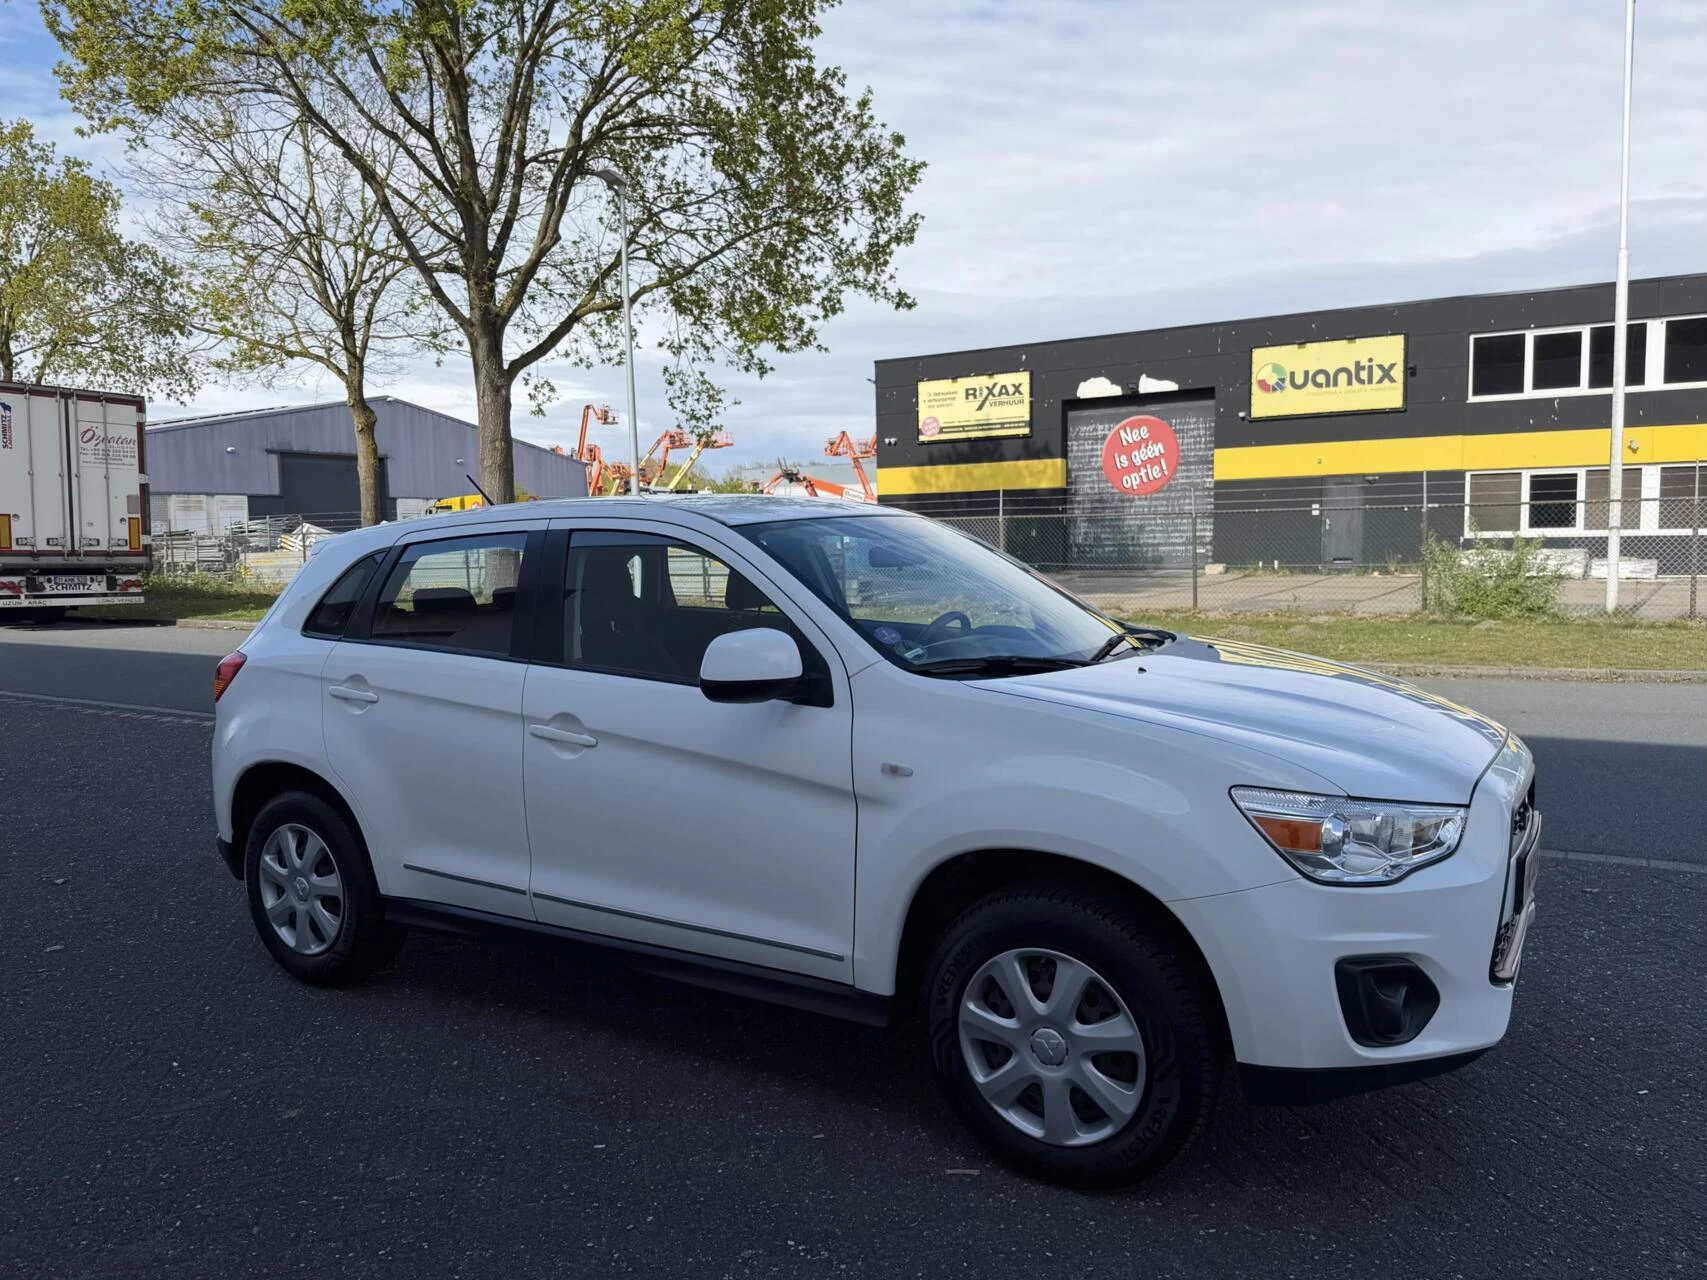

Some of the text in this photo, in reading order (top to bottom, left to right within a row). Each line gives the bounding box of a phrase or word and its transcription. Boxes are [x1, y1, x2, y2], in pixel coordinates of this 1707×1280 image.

[989, 399, 1025, 408] VERHUUR
[1119, 425, 1149, 446] Nee
[1114, 441, 1165, 470] is géén
